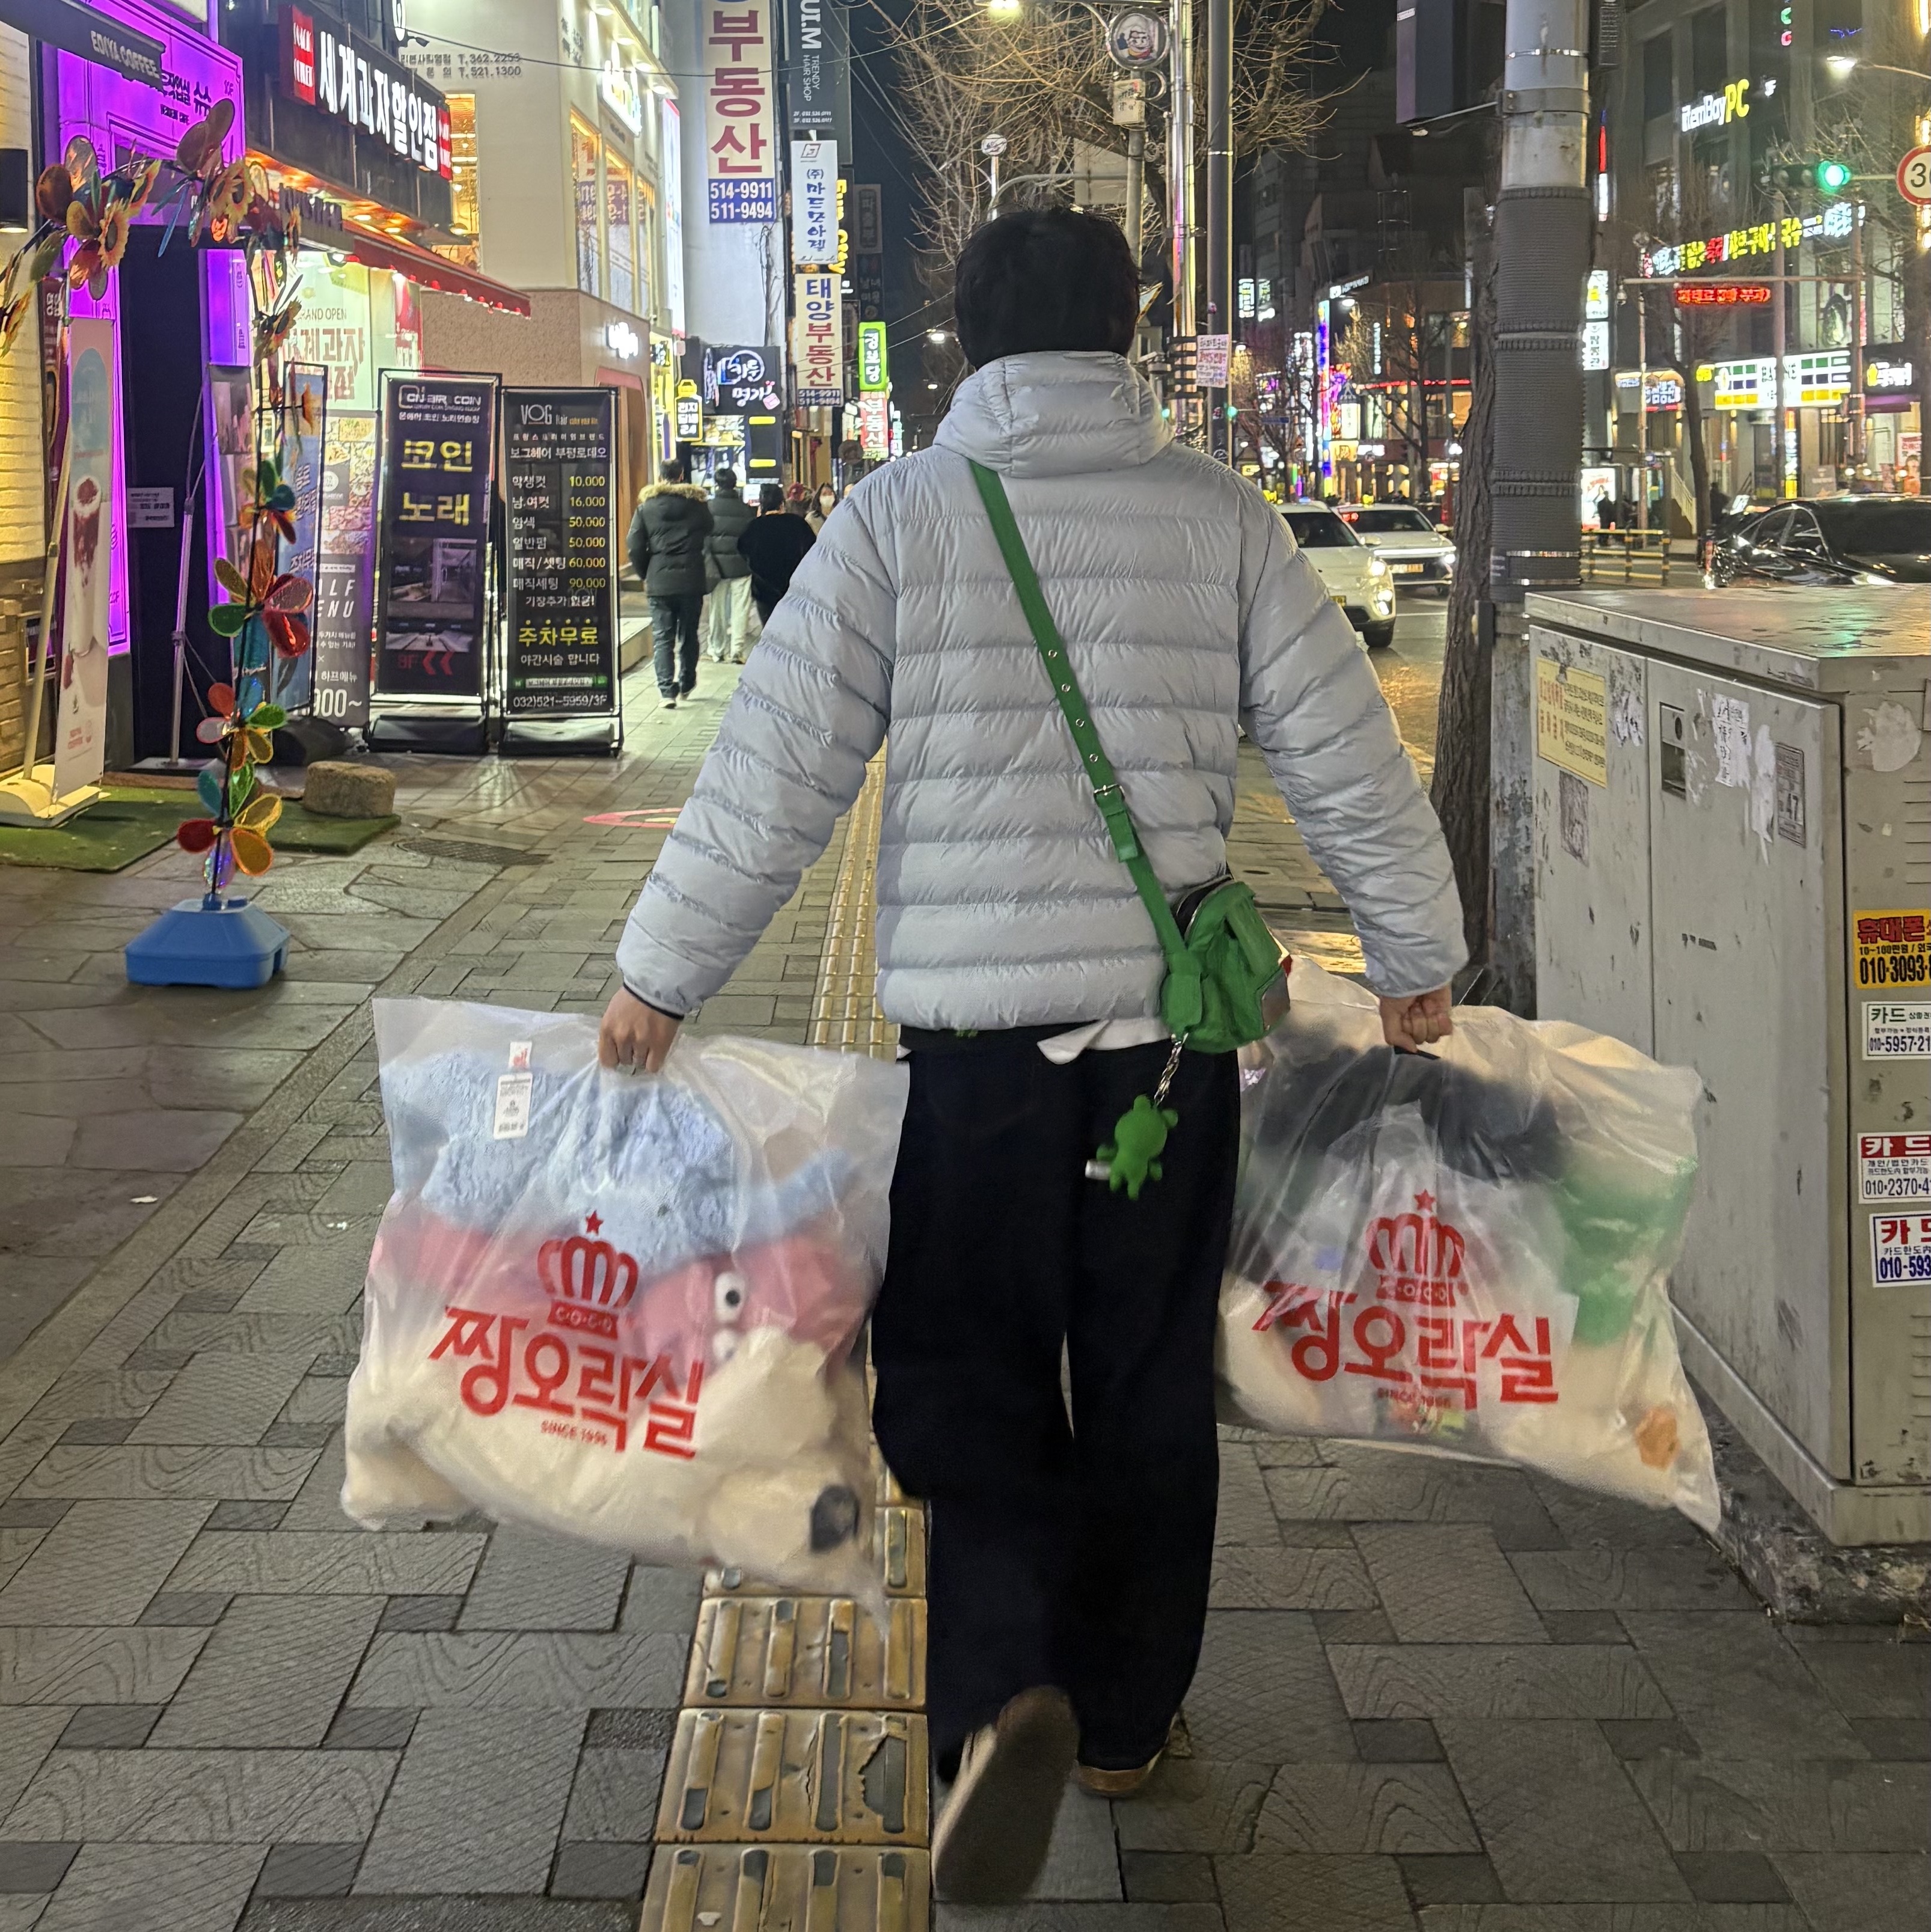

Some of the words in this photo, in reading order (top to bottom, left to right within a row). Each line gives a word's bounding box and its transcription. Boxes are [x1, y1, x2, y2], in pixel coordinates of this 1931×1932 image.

[91, 30, 121, 63] EDIYA
[120, 46, 160, 79] COFFEE
[812, 55, 820, 90] TRENDY
[709, 10, 767, 173] 부동산
[803, 78, 812, 102] SHOP
[319, 31, 438, 171] 세계과자할인점
[807, 169, 824, 179] (주)
[711, 182, 772, 199] 514-9911
[711, 201, 773, 219] 511-9494
[325, 307, 347, 320] OPEN
[806, 278, 836, 387] 태양부동산
[454, 396, 481, 405] COIN
[521, 405, 552, 425] VOG
[401, 439, 473, 472] 코인
[510, 447, 551, 459] 보그헤어
[555, 447, 607, 459] 부평로데오
[513, 475, 546, 489] 학생컷
[569, 476, 605, 488] 10,000
[399, 492, 470, 526] 노래
[570, 497, 605, 507] 16,000
[513, 516, 536, 530] 염색
[569, 516, 605, 528] 50,000
[513, 537, 547, 550] 일반펌
[569, 537, 605, 548] 50,000
[569, 557, 605, 568] 60,000
[569, 578, 605, 588] 90,000
[525, 596, 567, 608] 기장추가
[571, 596, 595, 607] 없음!
[519, 626, 599, 647] 주차무료
[521, 654, 564, 667] 야간시술
[568, 653, 600, 665] 합니다
[513, 695, 608, 708] 032)521-5959/3F
[1858, 916, 1925, 944] 휴대폰
[1871, 1007, 1906, 1024] 카드
[1865, 1137, 1930, 1157] 카드
[1252, 1281, 1558, 1410] 짱오락실
[428, 1306, 703, 1461] 짱오락실
